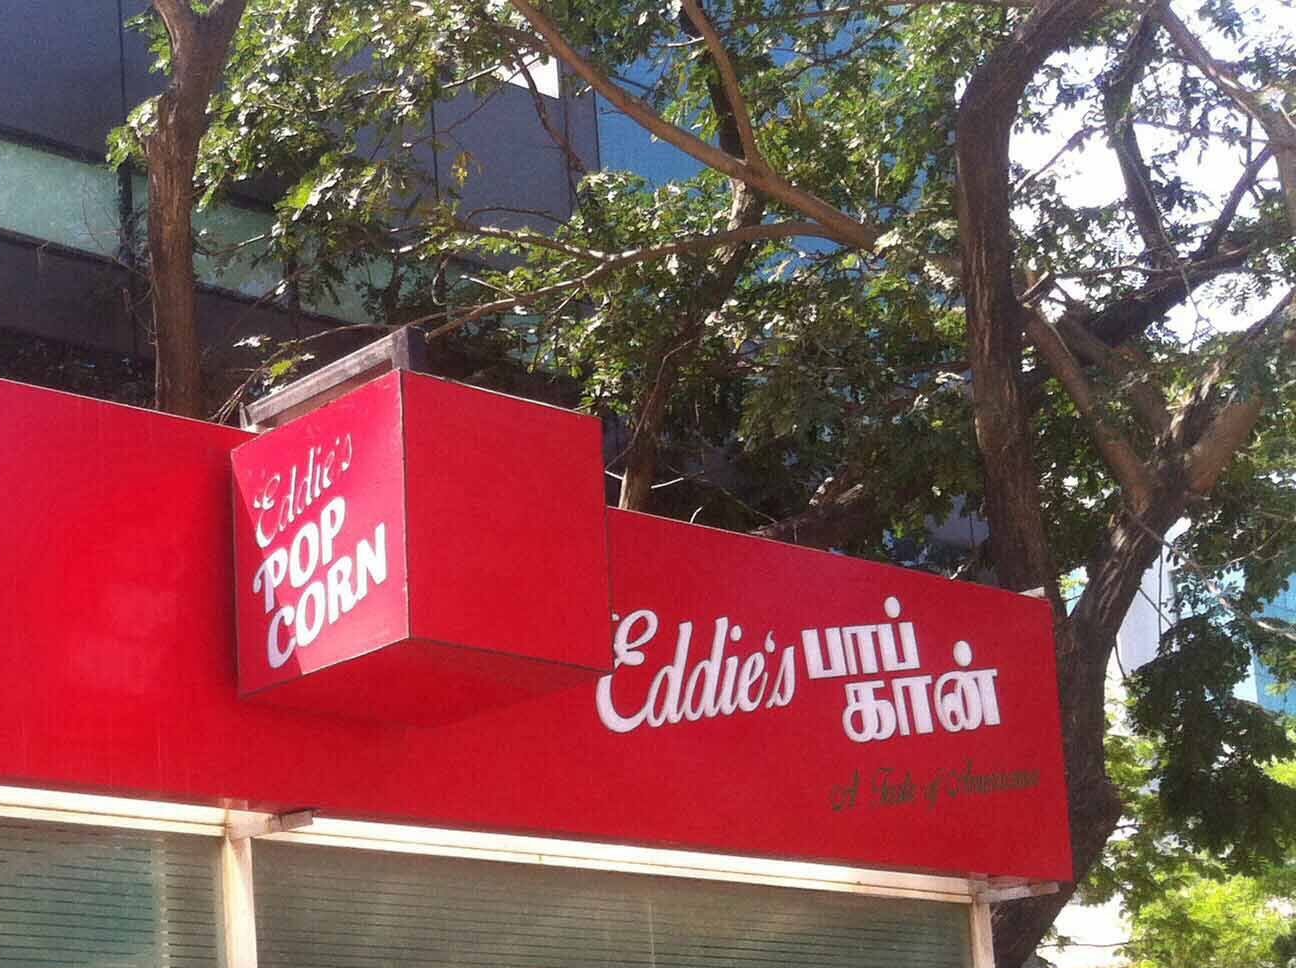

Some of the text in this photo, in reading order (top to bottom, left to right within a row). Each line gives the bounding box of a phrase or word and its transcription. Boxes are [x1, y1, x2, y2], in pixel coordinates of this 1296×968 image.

[253, 433, 353, 548] Eddie's
[252, 495, 346, 613] POP
[266, 522, 387, 669] CORN
[595, 608, 797, 733] Eddie's
[801, 596, 921, 680] பாப்
[842, 639, 1002, 743] கான்
